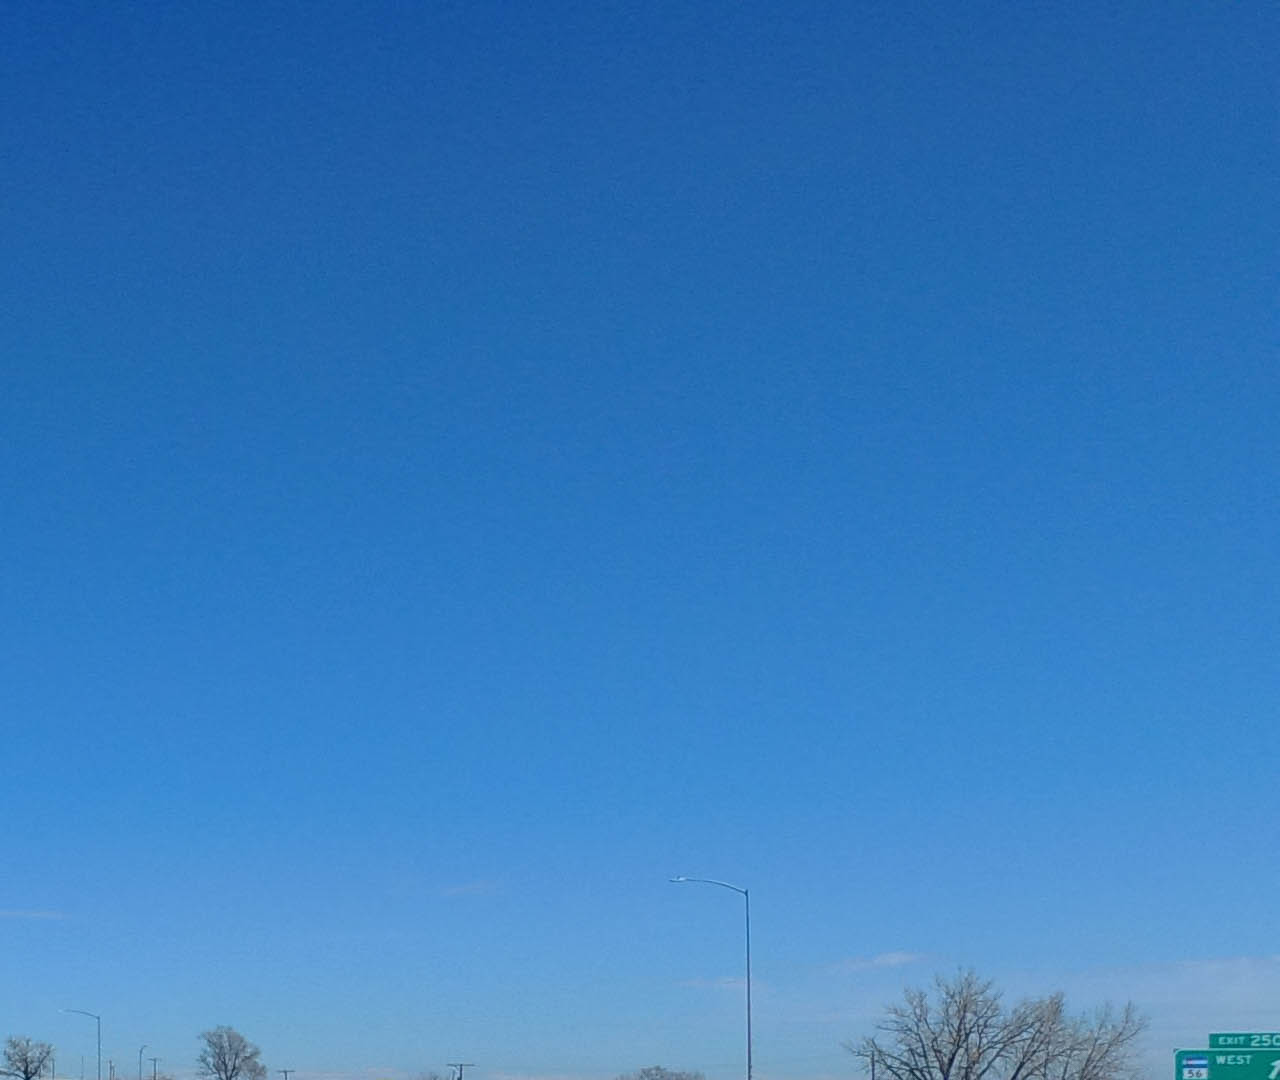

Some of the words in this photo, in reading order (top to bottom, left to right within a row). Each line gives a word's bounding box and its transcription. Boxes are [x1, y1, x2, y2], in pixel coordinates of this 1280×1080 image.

[1219, 1037, 1244, 1045] EXIT
[1216, 1056, 1251, 1065] WEST
[1187, 1069, 1202, 1078] 56
